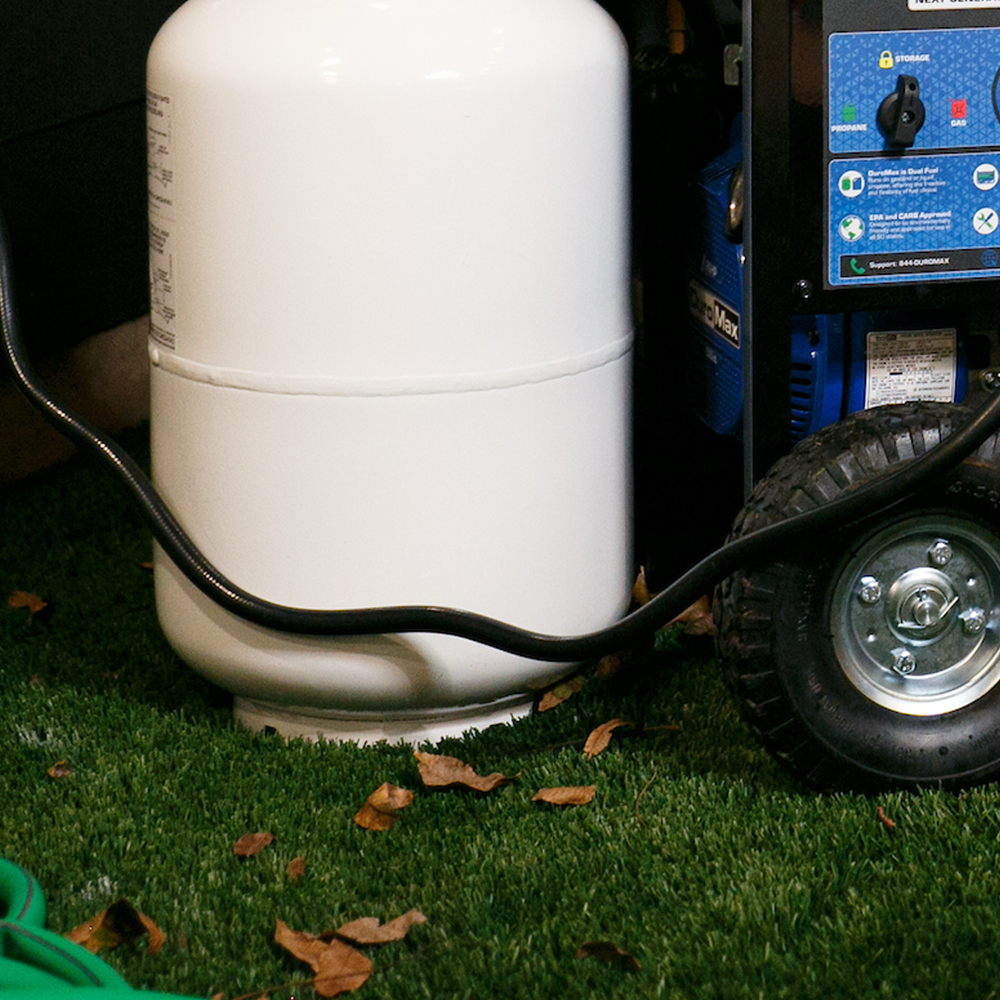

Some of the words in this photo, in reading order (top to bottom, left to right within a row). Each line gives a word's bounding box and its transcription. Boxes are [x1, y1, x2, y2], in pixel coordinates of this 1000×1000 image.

[895, 54, 930, 63] STORAGE
[951, 119, 967, 127] GAS
[831, 123, 867, 133] PROPANE
[868, 168, 899, 177] DuroMax
[869, 213, 884, 221] EPA
[920, 210, 952, 219] Approved
